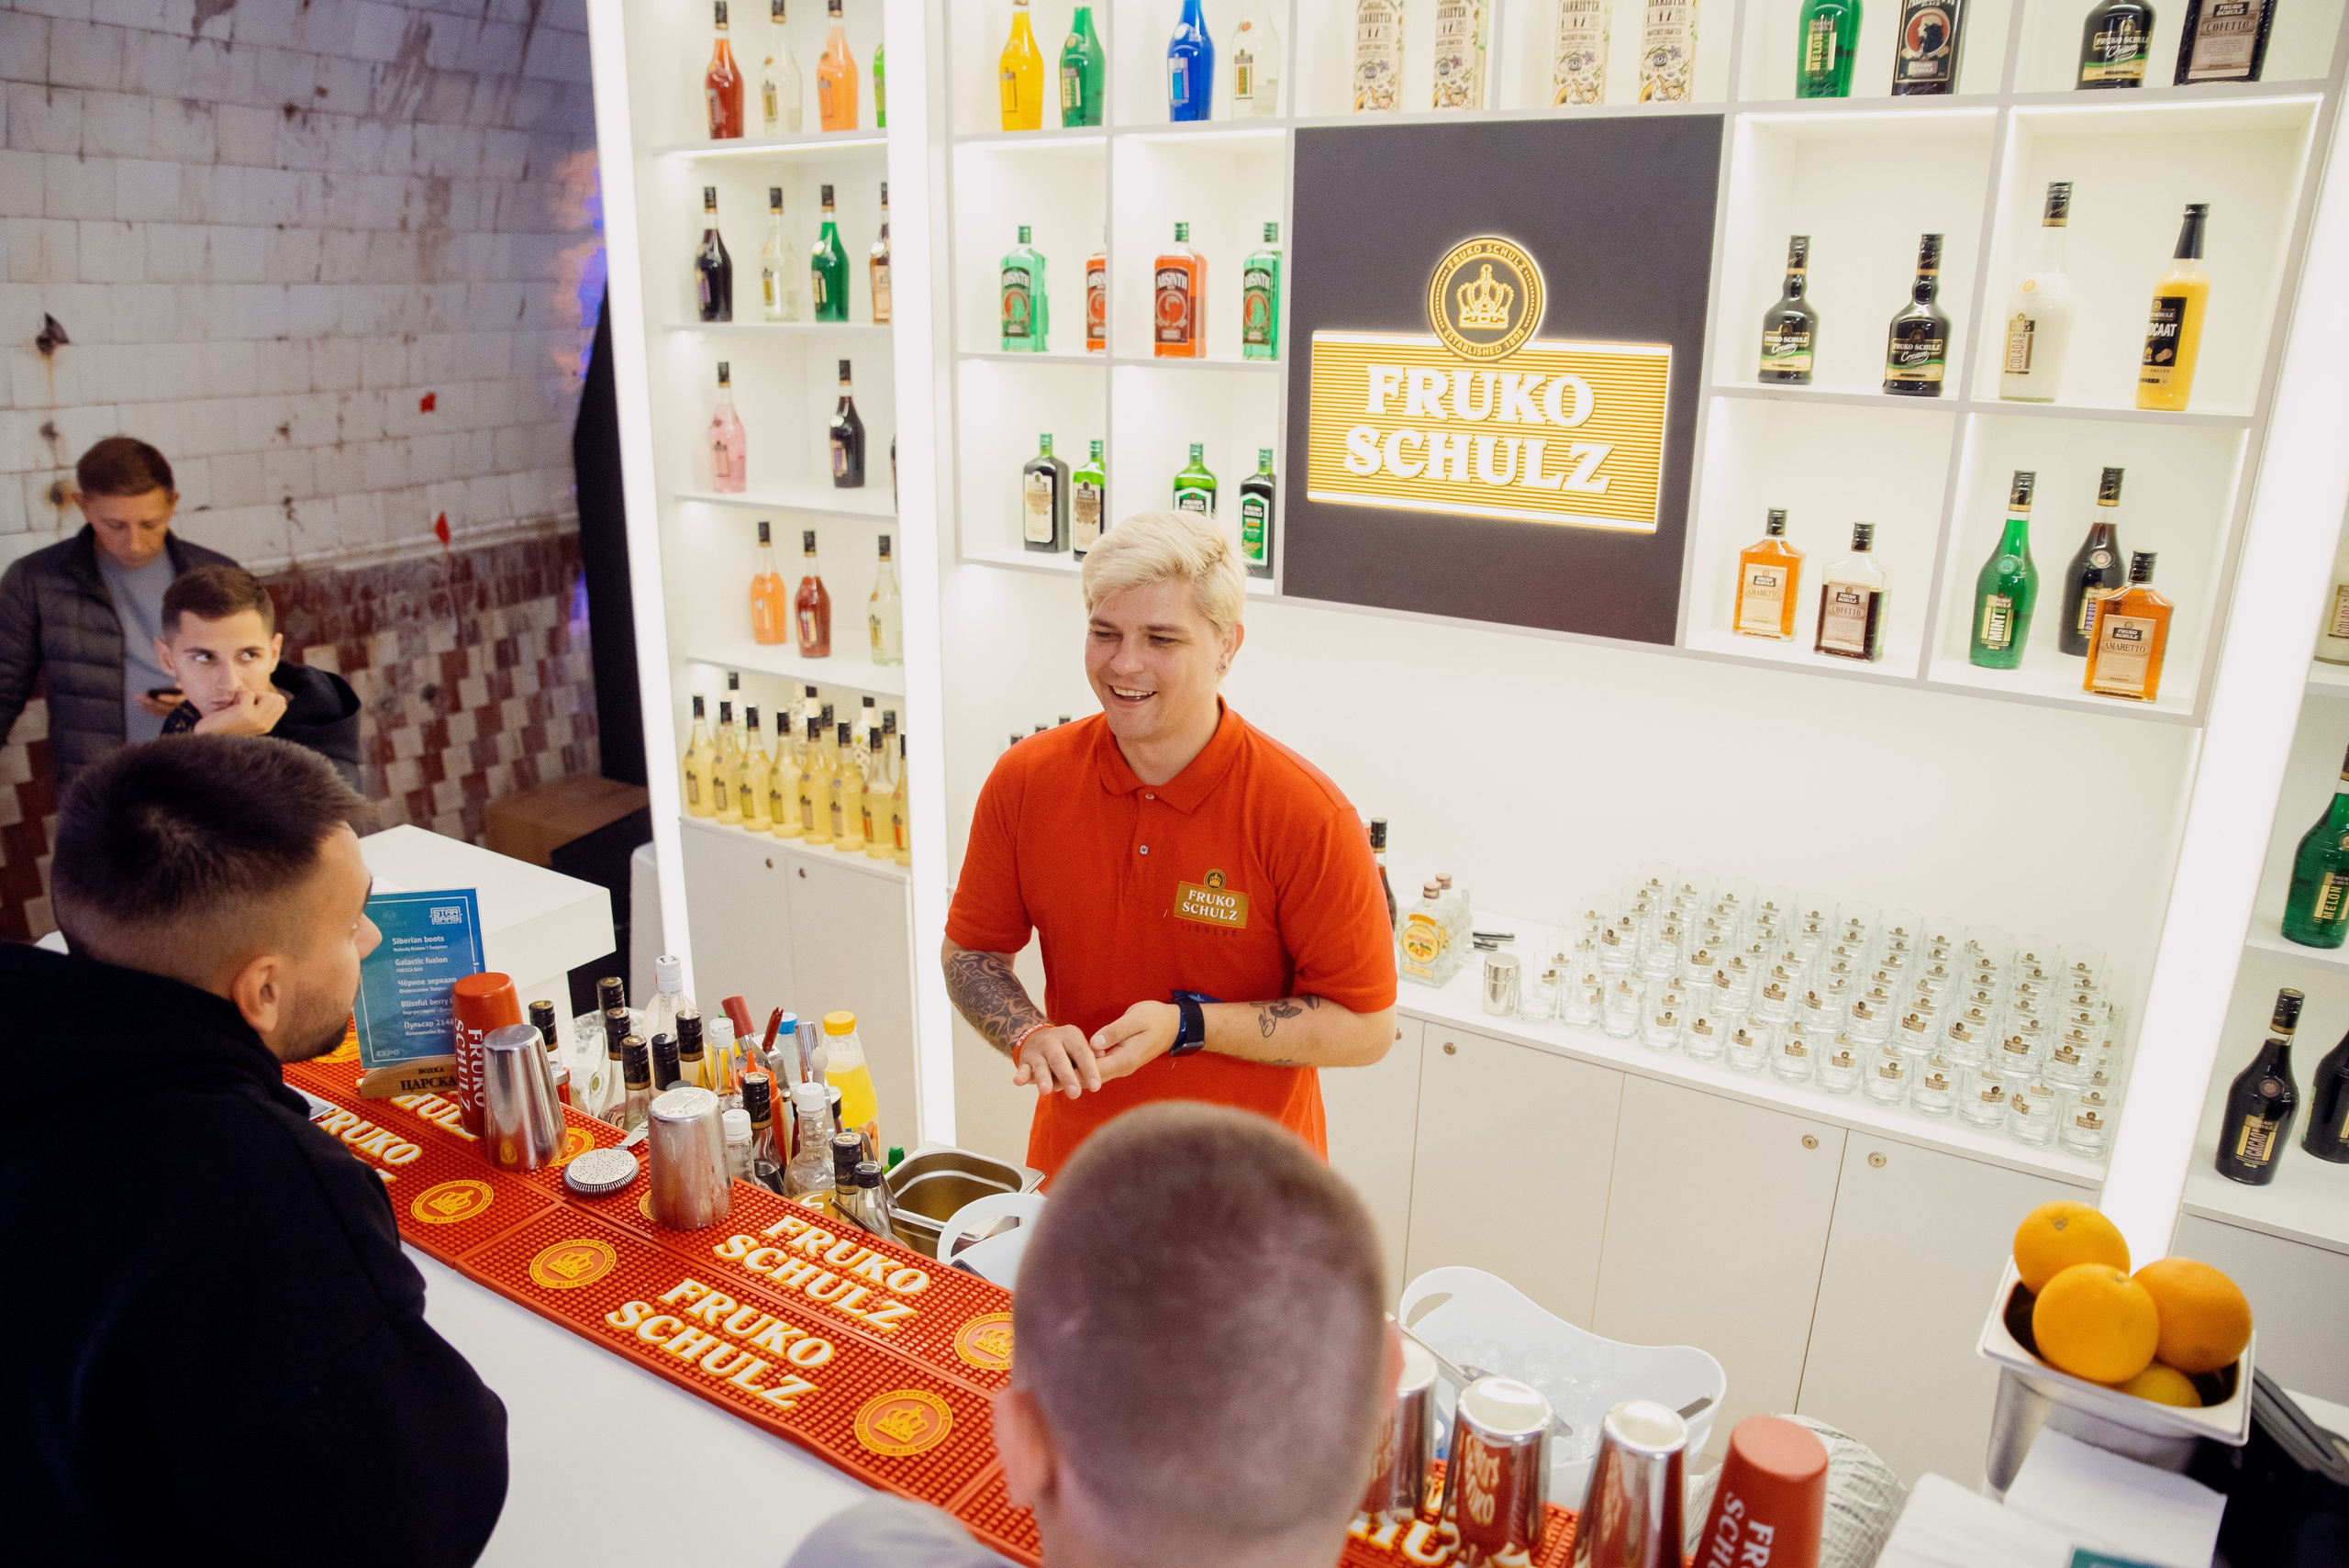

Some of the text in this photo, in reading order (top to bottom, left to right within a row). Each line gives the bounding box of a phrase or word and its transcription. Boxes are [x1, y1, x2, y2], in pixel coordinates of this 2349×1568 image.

[2206, 20, 2249, 32] COFETTO
[1811, 33, 1824, 71] MELON
[1447, 244, 1527, 272] FRUKO SCHULZ
[1444, 328, 1526, 356] ESTABLISHED 1898
[1900, 350, 1929, 362] Cream
[1365, 365, 1596, 428] FRUKO
[1343, 425, 1615, 495] SCHULZ
[1746, 588, 1780, 598] AMARETTO
[1987, 612, 2006, 641] MINT
[2104, 641, 2146, 653] AMARETTO
[432, 907, 459, 917] STAR
[1182, 902, 1238, 921] SCHULZ
[1188, 890, 1236, 908] FRUKO
[2321, 886, 2343, 920] MELON
[392, 935, 445, 945] Siberian boots
[395, 958, 424, 966] Galactic
[397, 977, 457, 987] Чёрное зеркало
[401, 998, 449, 1007] Blissful berry
[404, 1020, 434, 1030] Пульсар
[417, 1066, 446, 1075] ВОДКА
[455, 1018, 472, 1112] SCHULZ
[319, 1106, 422, 1165] RUKO
[2245, 1131, 2267, 1157] CACAO
[761, 1215, 930, 1294] FRUKO
[713, 1234, 918, 1331] SCHULZ
[657, 1277, 835, 1368] FRUKO
[605, 1300, 818, 1411] SCHULZ
[1708, 1491, 1745, 1568] SCH
[1741, 1519, 1775, 1568] FR
